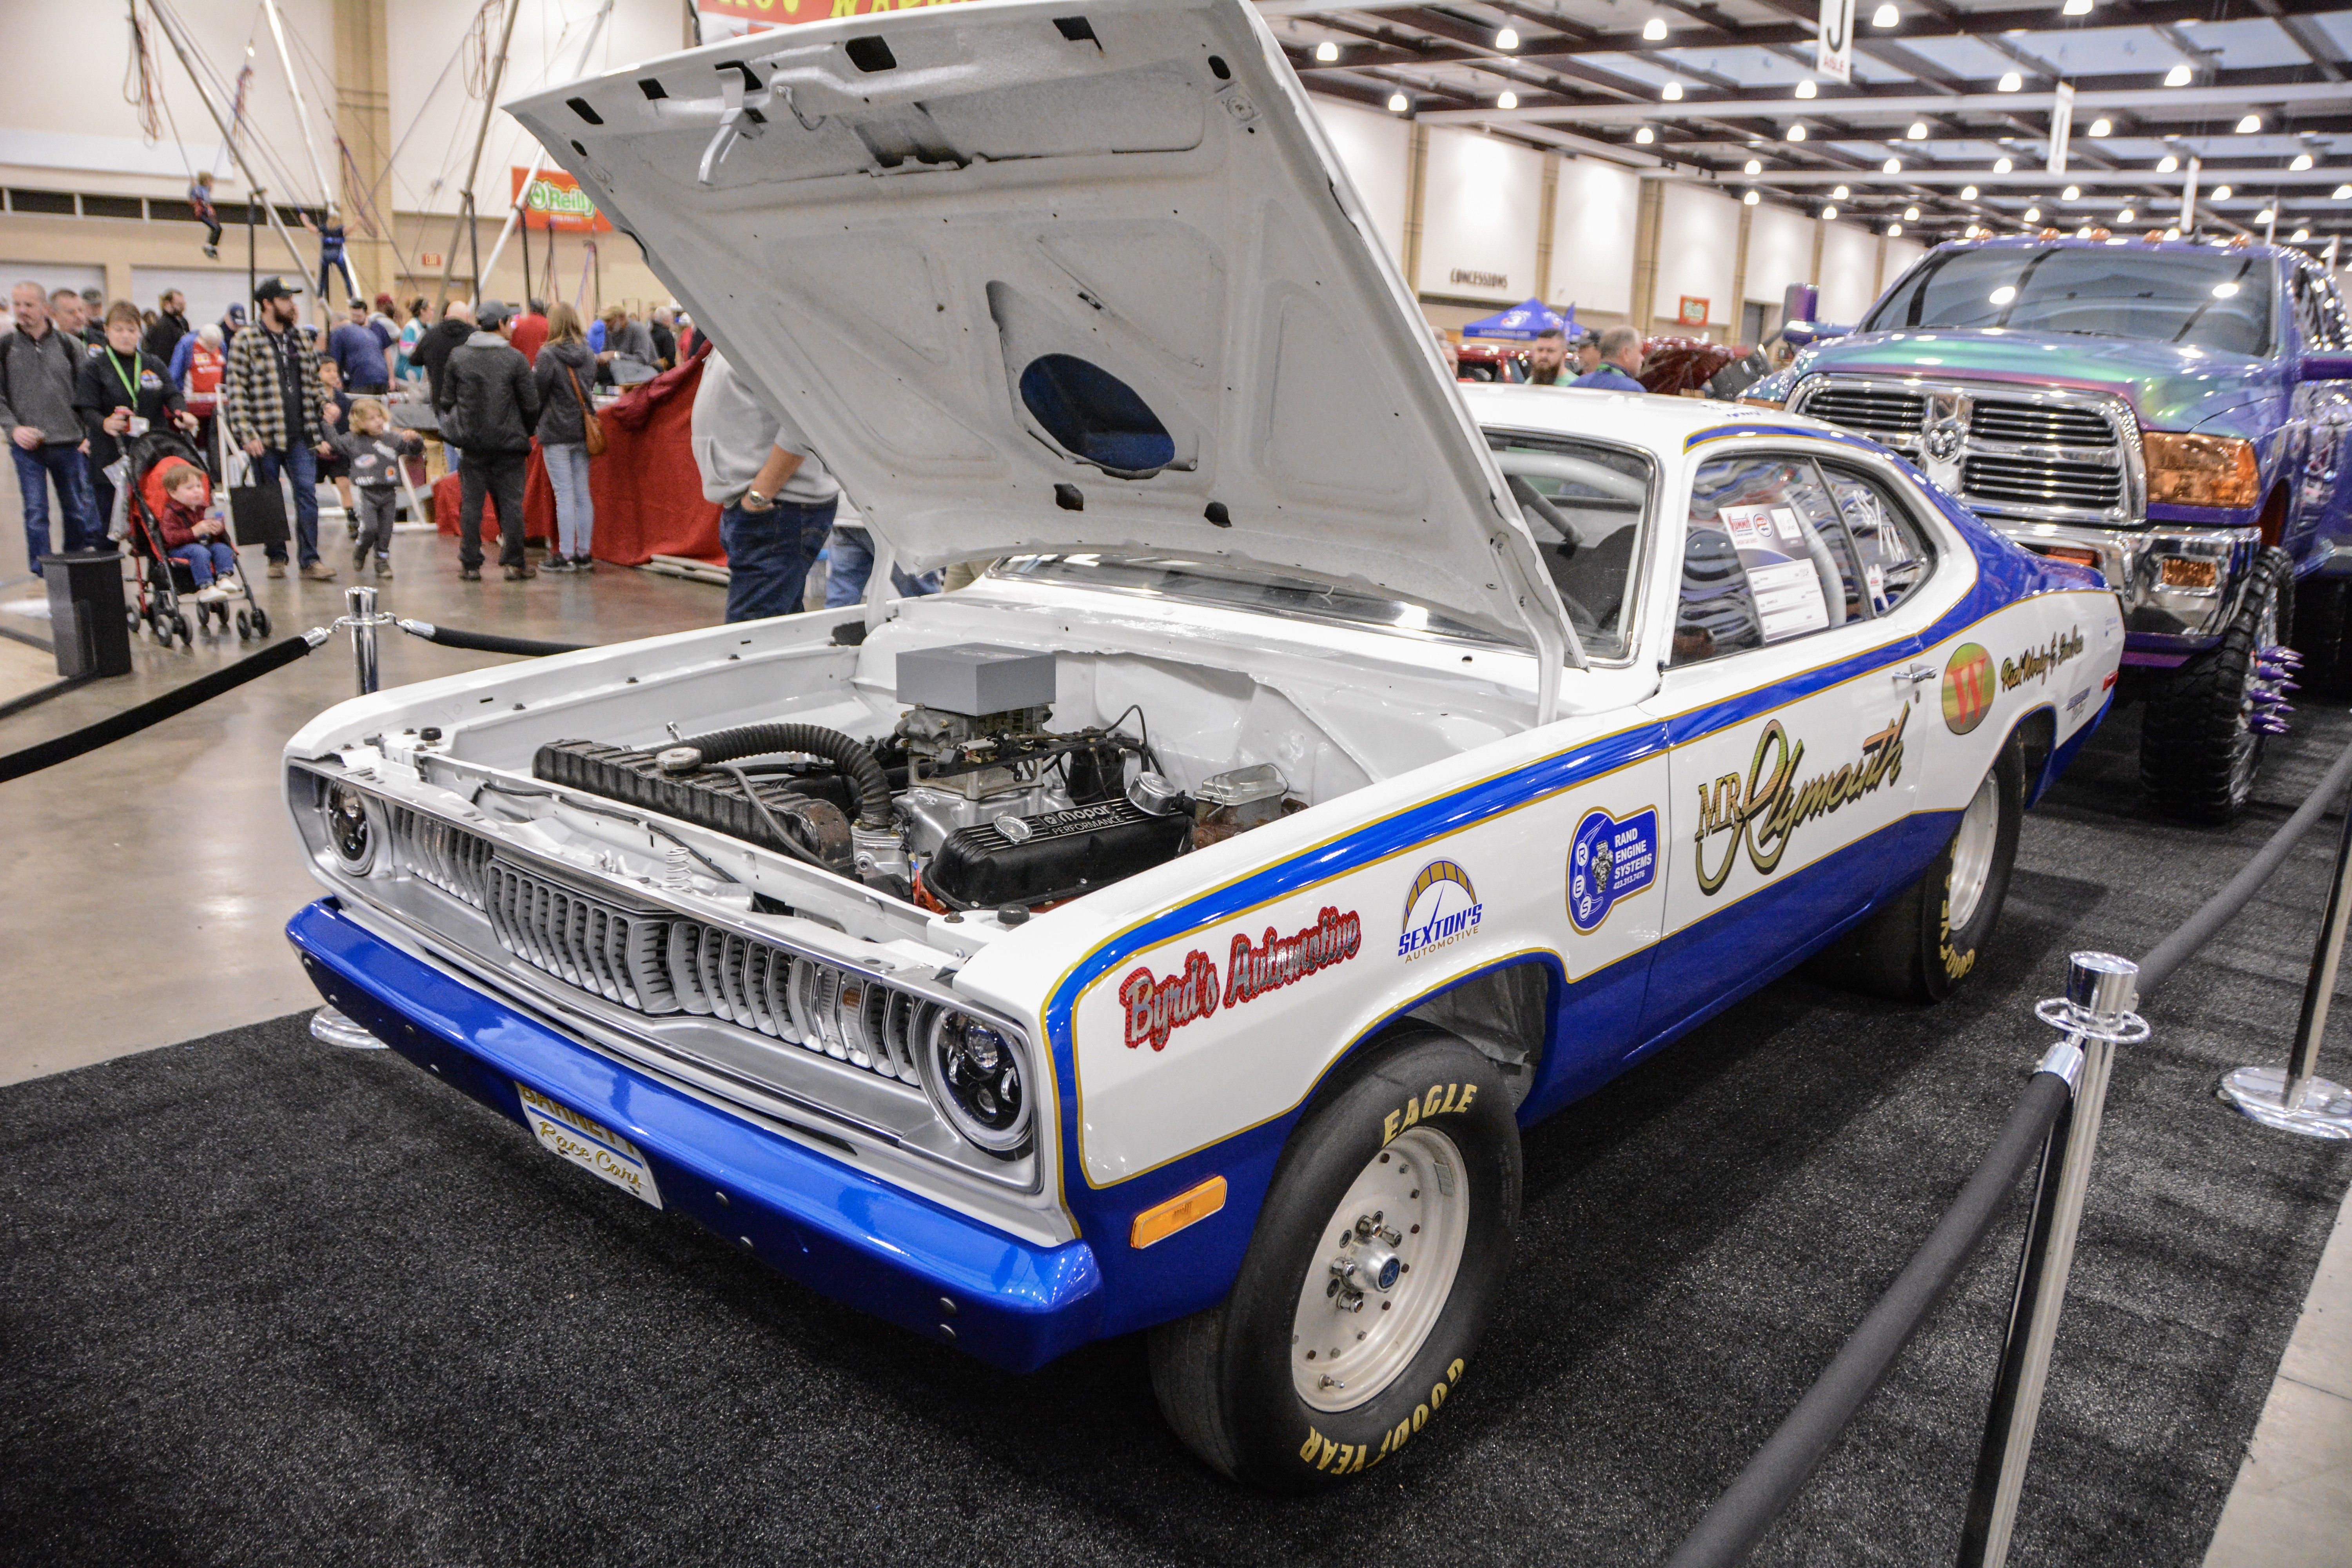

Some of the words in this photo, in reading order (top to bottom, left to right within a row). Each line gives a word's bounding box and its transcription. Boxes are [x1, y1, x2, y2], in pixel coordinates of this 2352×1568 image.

[1450, 268, 1508, 290] CONCESSIONS
[1951, 657, 1987, 725] W
[1051, 815, 1124, 835] PERFORMANCE
[1695, 699, 1911, 897] Plymouth
[1695, 771, 1744, 843] MR
[1614, 827, 1639, 848] RAND
[1615, 839, 1647, 864] ENGINE
[1614, 853, 1653, 880] SYSTEMS
[1397, 903, 1483, 957] SEXTON'S
[1405, 925, 1479, 964] AUTOMOTIVE
[1123, 955, 1217, 1048] Byrd's
[1227, 912, 1360, 1005] Automotive
[1381, 1083, 1478, 1149] EAGLE
[538, 1121, 592, 1163] Race
[595, 1150, 643, 1189] Cars
